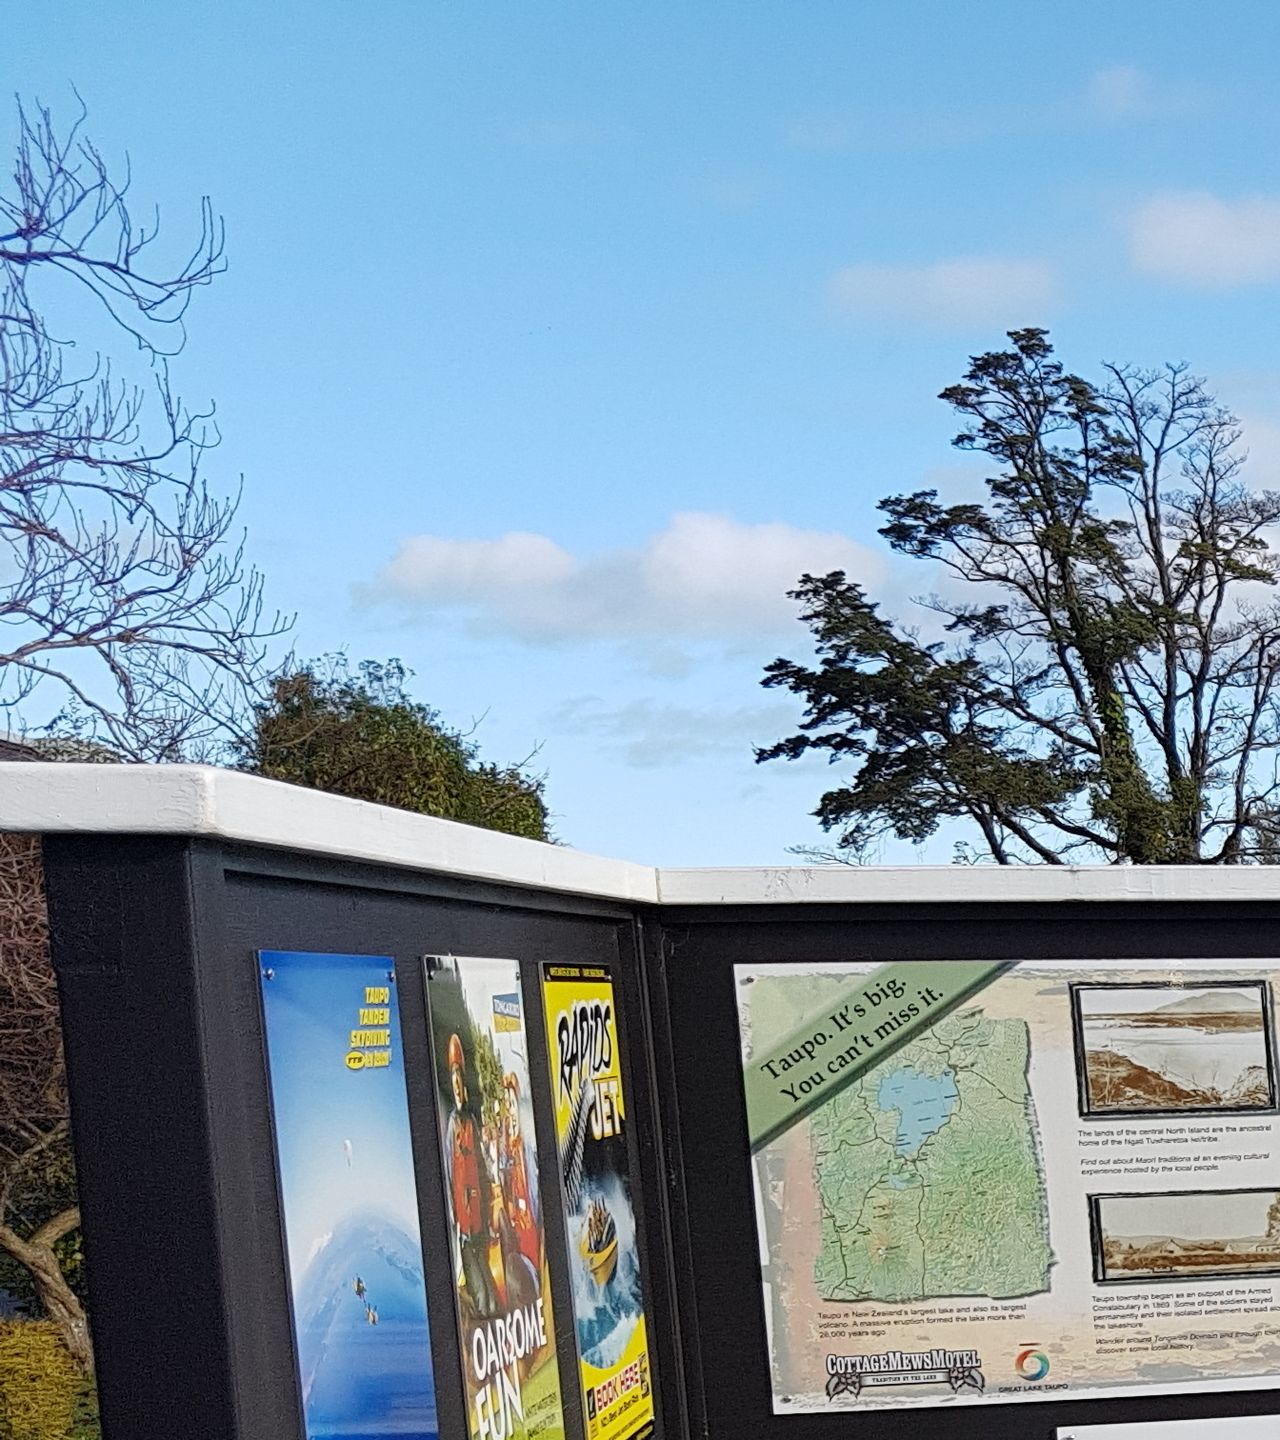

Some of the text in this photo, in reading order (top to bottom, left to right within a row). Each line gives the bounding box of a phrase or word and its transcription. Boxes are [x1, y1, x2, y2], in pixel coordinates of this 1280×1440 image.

[761, 978, 906, 1079] Taupo. It's big.
[780, 987, 943, 1102] You can't miss it.
[591, 1078, 622, 1140] JET
[472, 1297, 547, 1381] OARSOME
